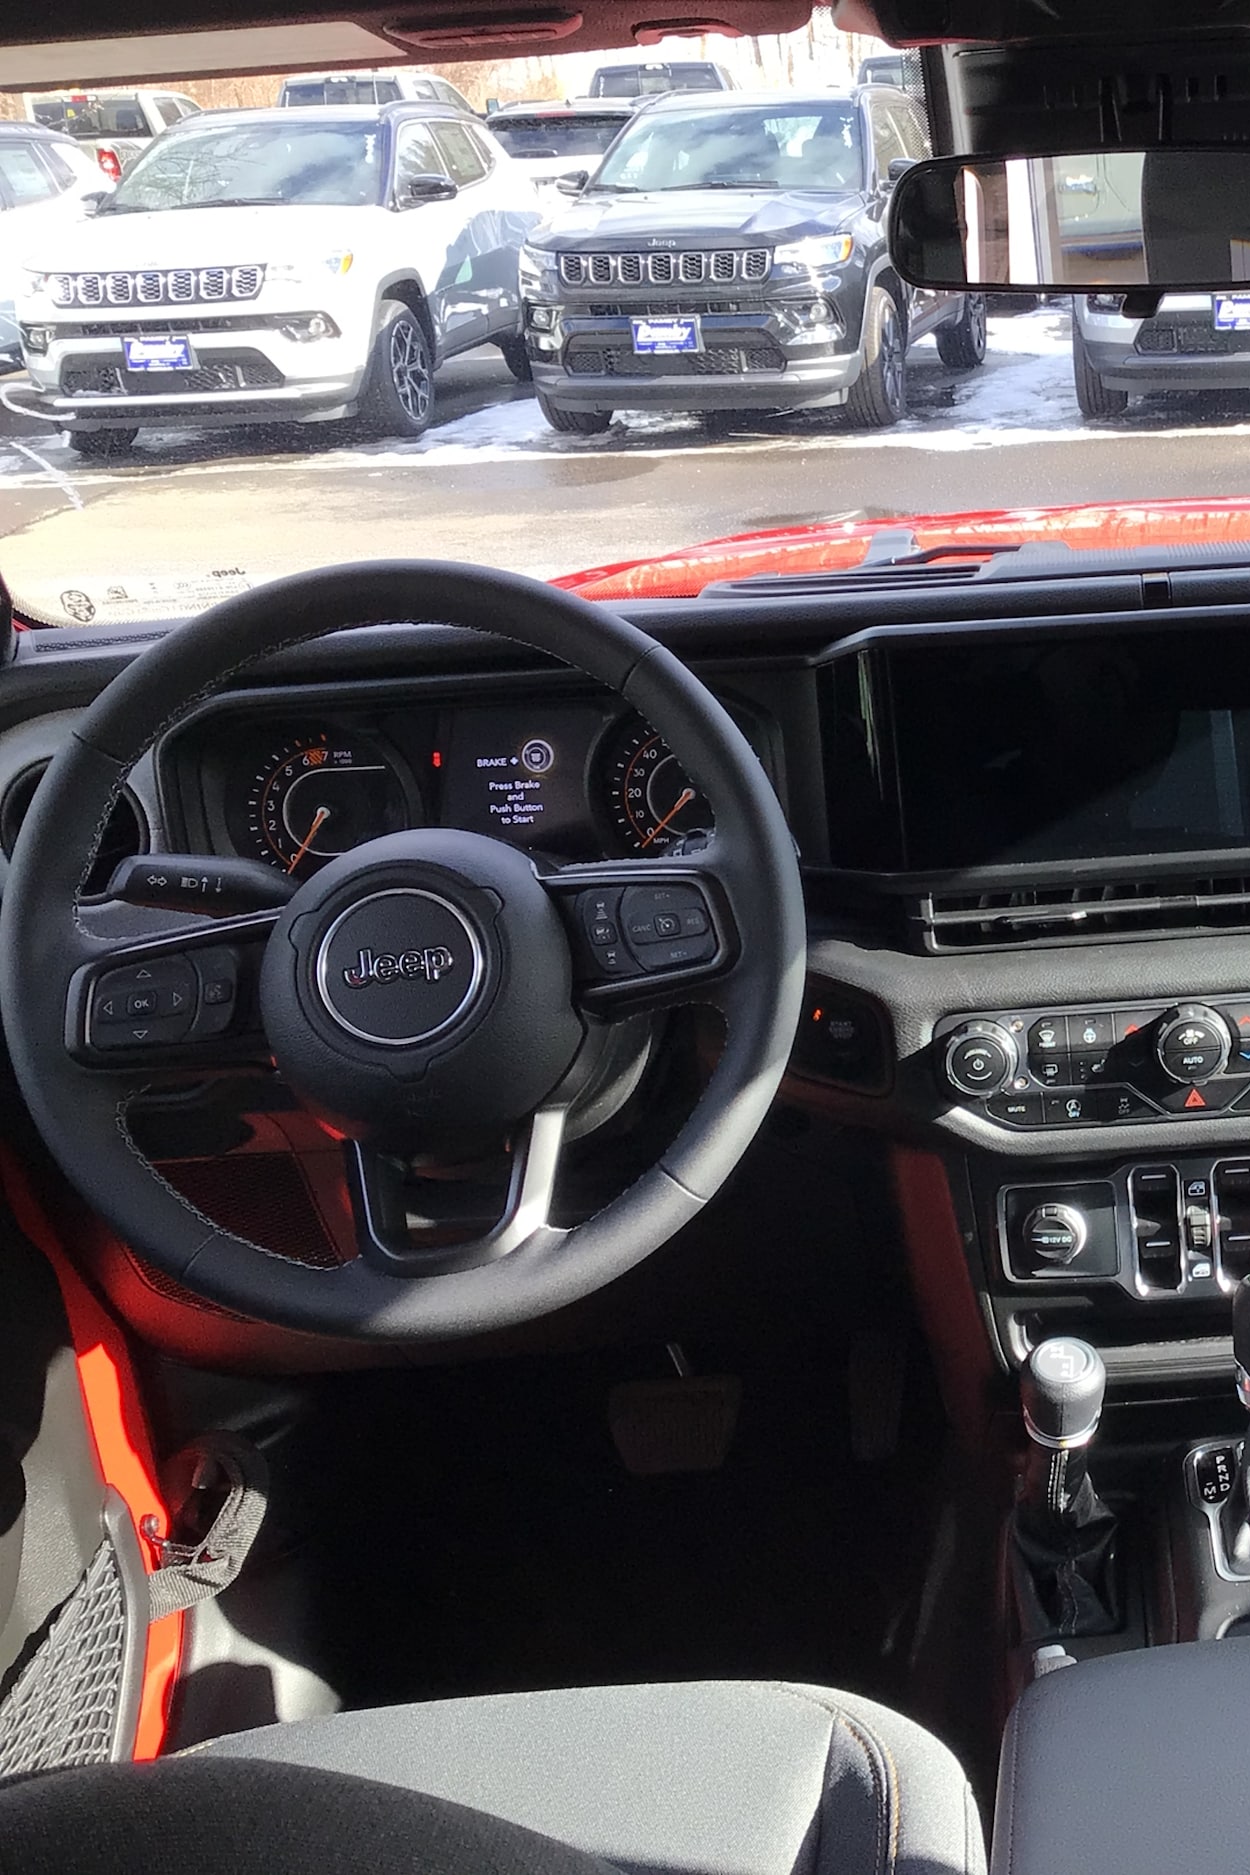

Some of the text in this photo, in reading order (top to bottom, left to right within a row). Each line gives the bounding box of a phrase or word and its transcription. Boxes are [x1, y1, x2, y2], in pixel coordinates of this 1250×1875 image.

[648, 238, 676, 248] Jeep
[321, 751, 329, 761] 7
[642, 749, 658, 759] 40
[302, 756, 309, 766] 6
[477, 757, 507, 767] BRAKE
[285, 765, 293, 776] 5
[633, 768, 645, 777] 30
[272, 782, 280, 791] 4
[489, 780, 540, 791] Press Brake
[507, 792, 524, 801] and
[628, 787, 642, 798] 20
[267, 800, 275, 811] 3
[490, 803, 543, 813] Push Button
[512, 815, 534, 823] Start
[635, 810, 645, 818] 10
[269, 820, 276, 830] 2
[344, 945, 454, 987] Jeep
[134, 996, 149, 1009] OK
[1183, 1037, 1198, 1045] OFF
[1183, 1056, 1204, 1064] AUTO
[1008, 1105, 1026, 1113] MUTE
[1215, 1455, 1225, 1464] P
[1217, 1465, 1227, 1473] R
[1218, 1473, 1229, 1482] N
[1204, 1486, 1217, 1496] M
[1220, 1483, 1230, 1491] D
